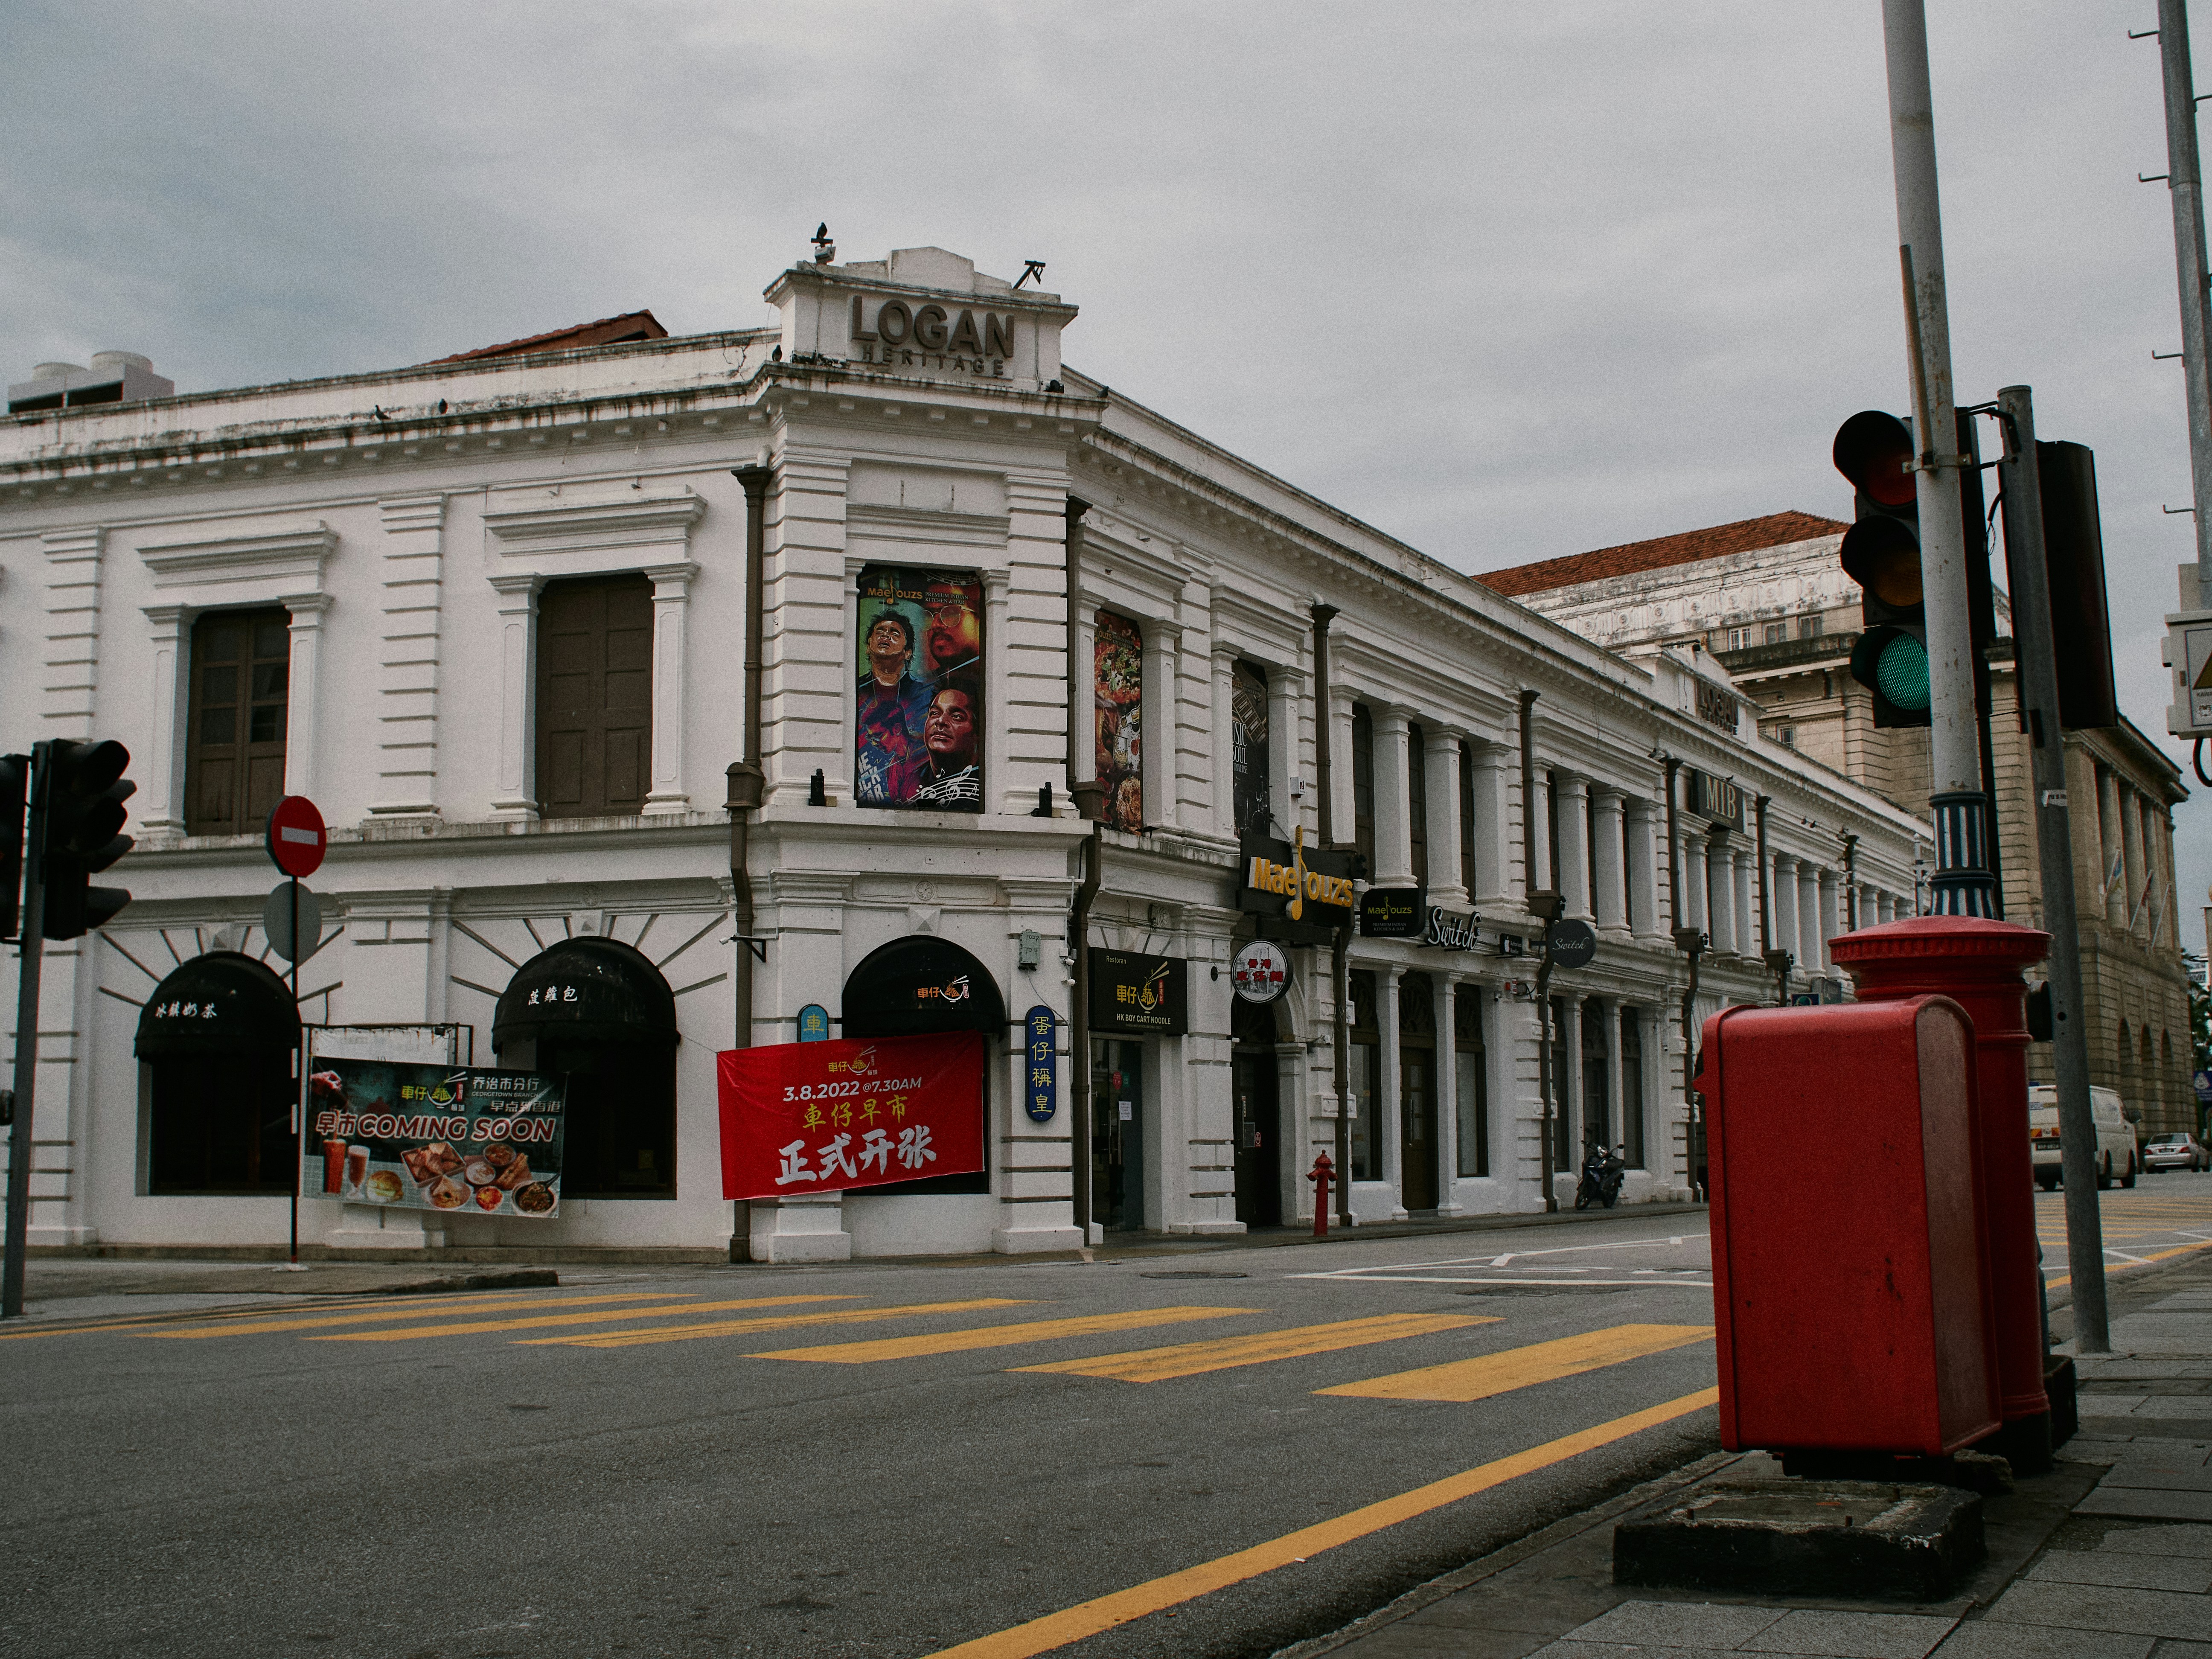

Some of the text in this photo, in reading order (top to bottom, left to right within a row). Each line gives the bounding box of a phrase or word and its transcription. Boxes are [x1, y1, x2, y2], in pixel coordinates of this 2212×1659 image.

[852, 295, 1015, 358] LOGAN
[862, 344, 1004, 376] HERITAGE
[1706, 774, 1737, 819] MIB
[1428, 905, 1481, 950] Switch
[1552, 937, 1589, 950] Switch
[1106, 955, 1126, 964] Restoran
[803, 1014, 824, 1034] 車
[1137, 1015, 1150, 1023] CART
[1151, 1016, 1171, 1025] NOODLE
[472, 1077, 540, 1091] 乔治市分行
[783, 1081, 860, 1102] 3.8.2022
[358, 1113, 468, 1141] COMING
[470, 1117, 556, 1143] SOON
[802, 1094, 908, 1133] 車仔早市
[775, 1124, 937, 1185] 正式开张
